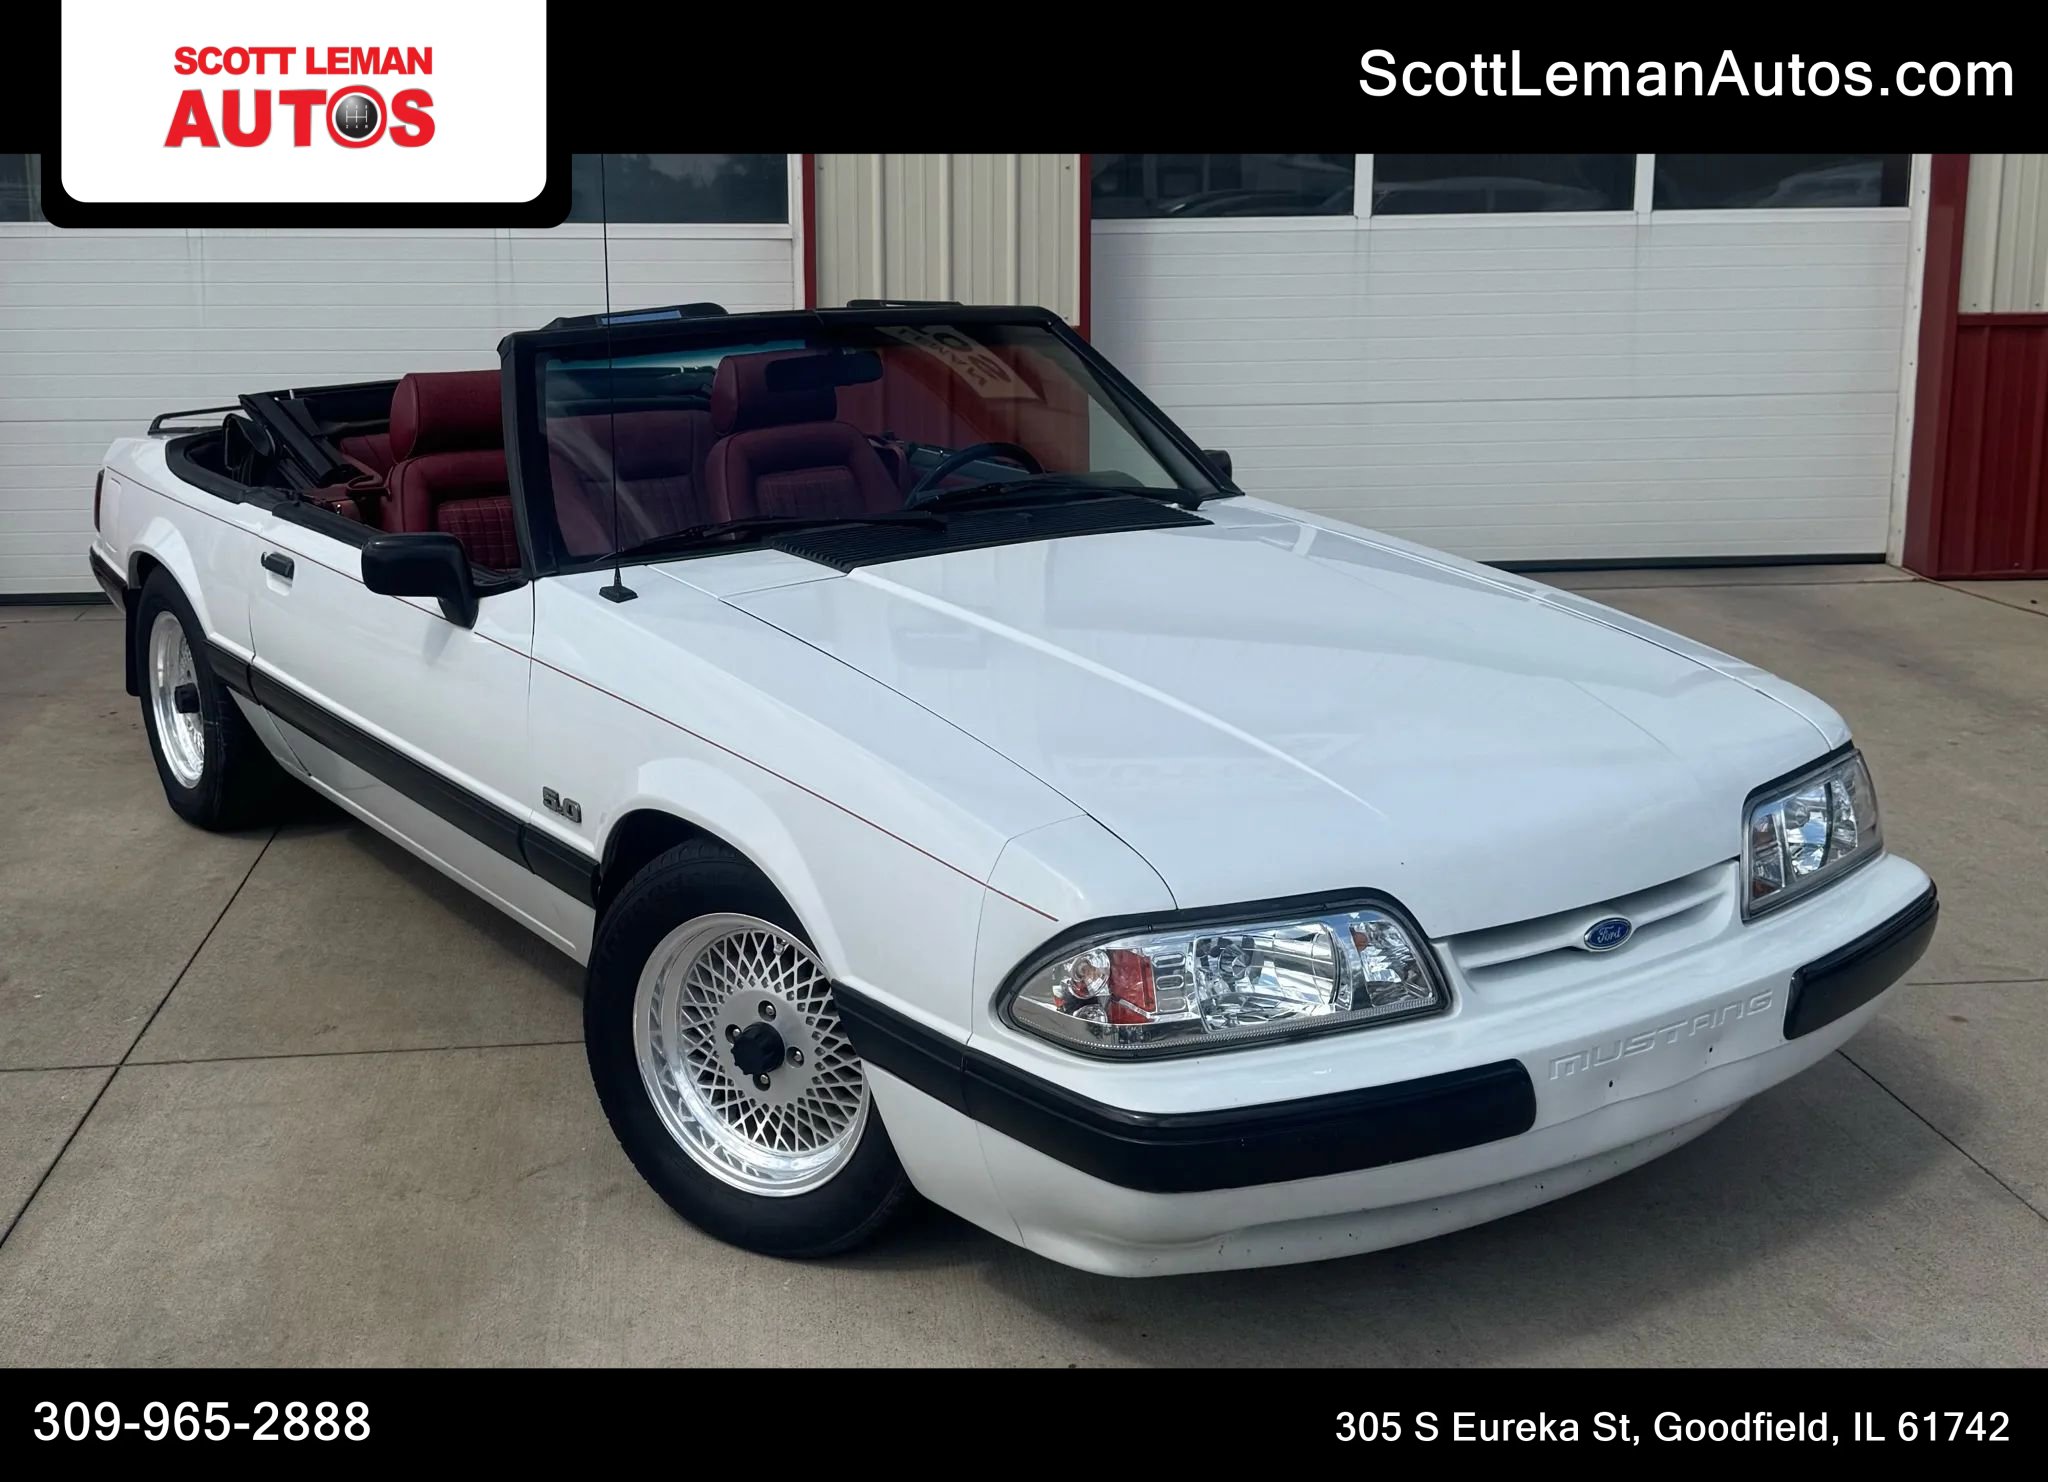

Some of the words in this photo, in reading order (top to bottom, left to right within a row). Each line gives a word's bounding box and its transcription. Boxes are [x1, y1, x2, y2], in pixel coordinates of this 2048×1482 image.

[542, 786, 582, 823] 5.0
[1596, 925, 1622, 944] Ford
[1549, 987, 1774, 1081] MUSTANG
